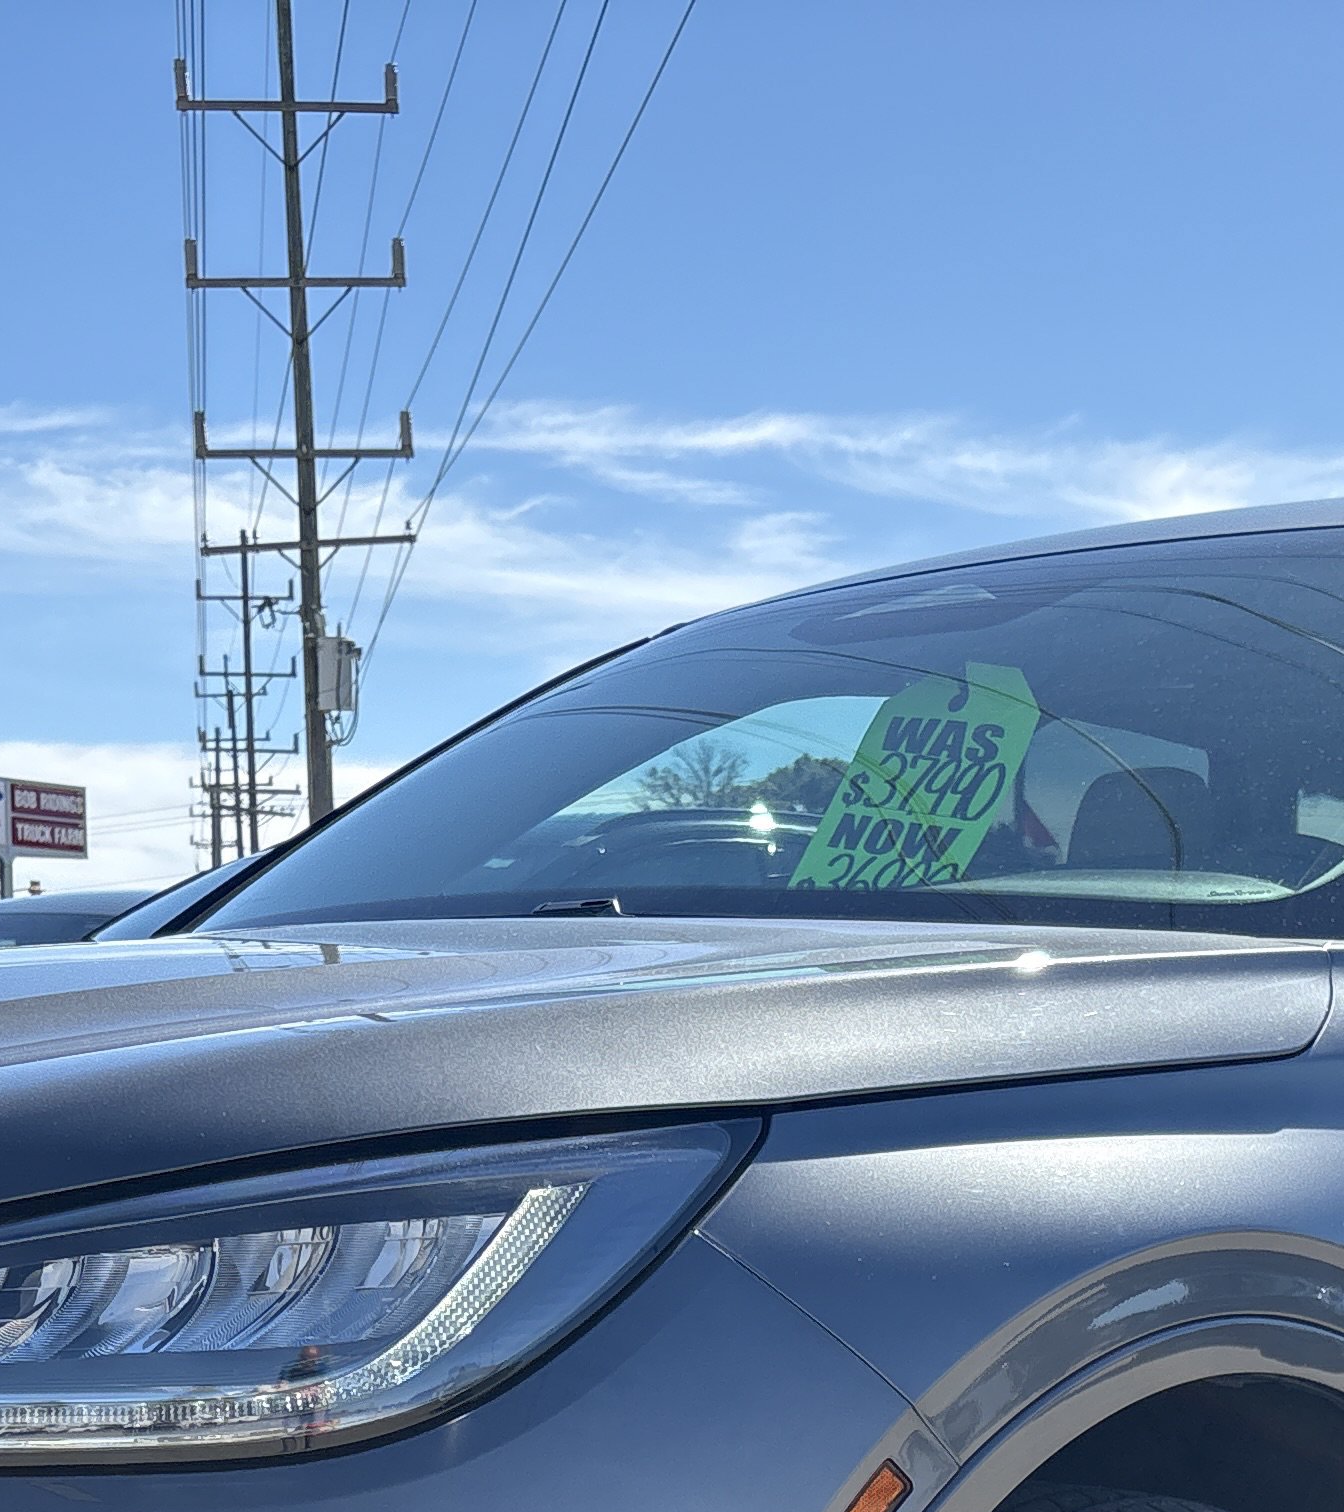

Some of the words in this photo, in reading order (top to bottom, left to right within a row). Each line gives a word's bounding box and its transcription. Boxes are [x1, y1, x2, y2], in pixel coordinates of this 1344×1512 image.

[882, 716, 1006, 764] WAS
[14, 789, 37, 809] BOB
[841, 751, 1007, 822] $37990
[16, 822, 52, 843] TRUCK
[53, 827, 85, 847] FARM
[827, 812, 966, 864] NOW
